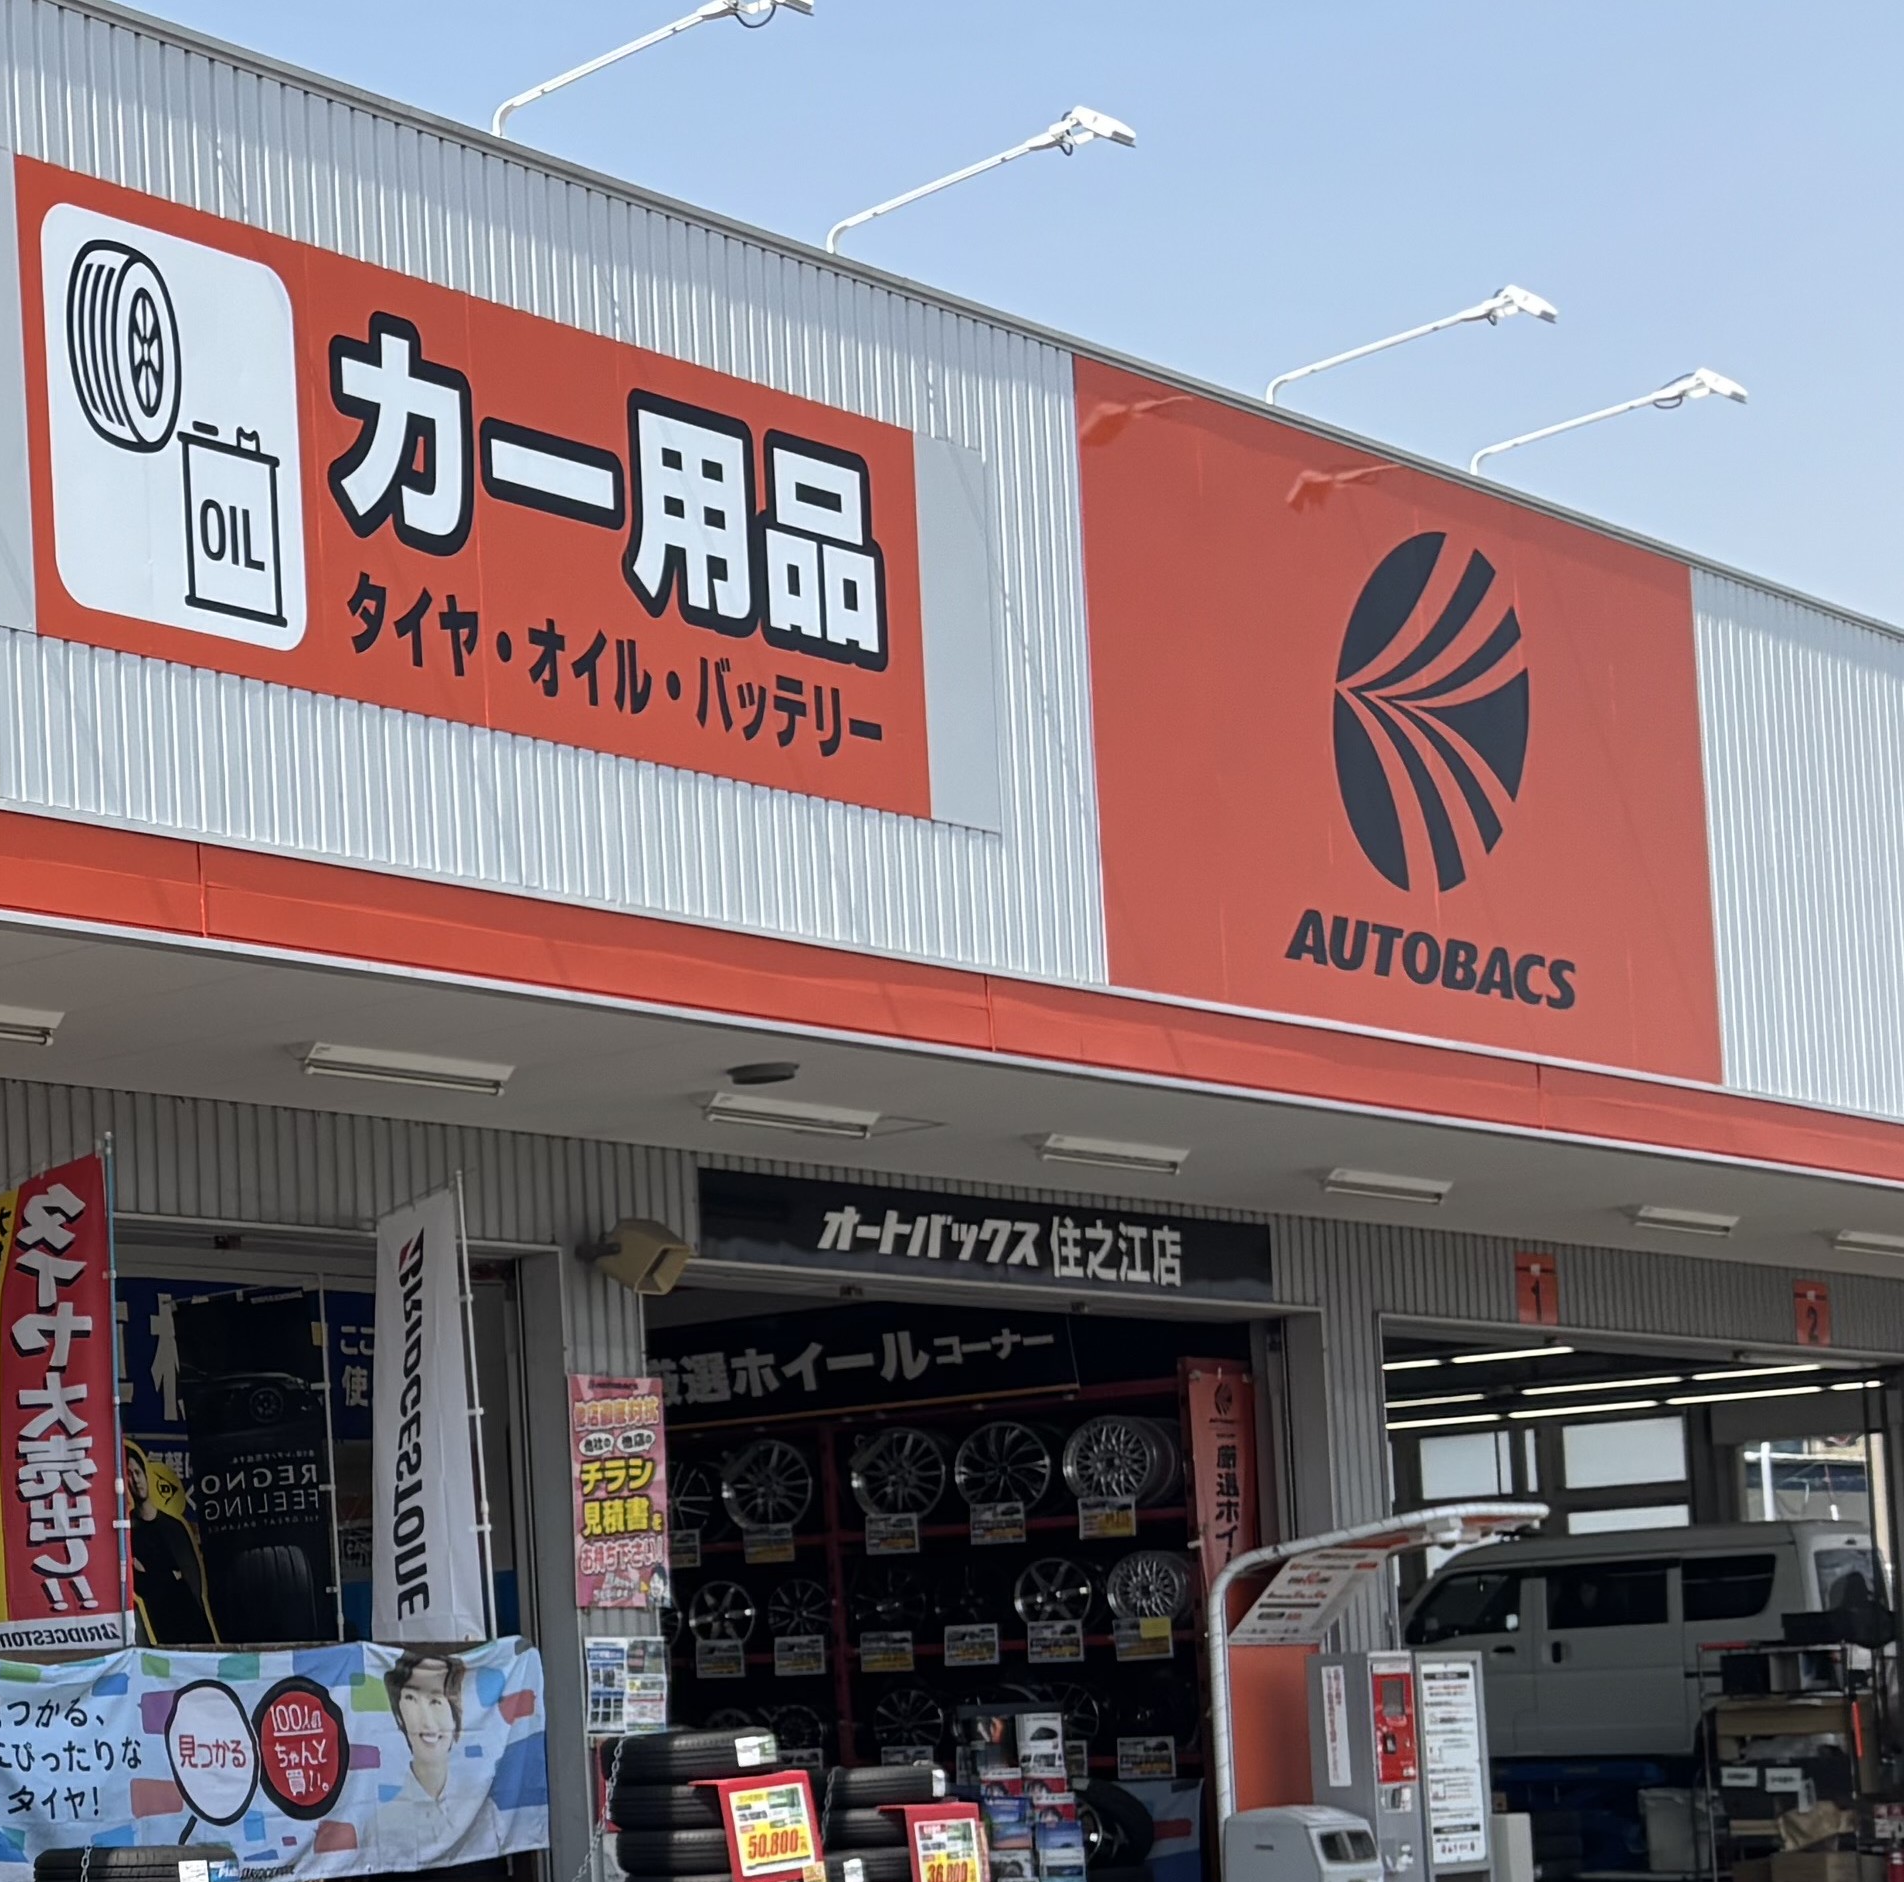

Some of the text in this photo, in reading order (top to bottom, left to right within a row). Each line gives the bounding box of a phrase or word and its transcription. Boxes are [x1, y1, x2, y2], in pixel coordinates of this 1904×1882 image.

[328, 312, 888, 671] カー用品
[199, 499, 265, 573] OIL
[347, 572, 883, 757] タイヤ・オイル・バッテリー
[1284, 908, 1577, 1010] AUTOBACS
[817, 1206, 1182, 1287] オートバックス 住之江店
[1529, 1281, 1541, 1323] 1
[1806, 1305, 1820, 1341] 2
[580, 1457, 656, 1497] チラシ
[178, 1733, 247, 1771] 見つかる
[7, 1785, 101, 1820] タイヤ!
